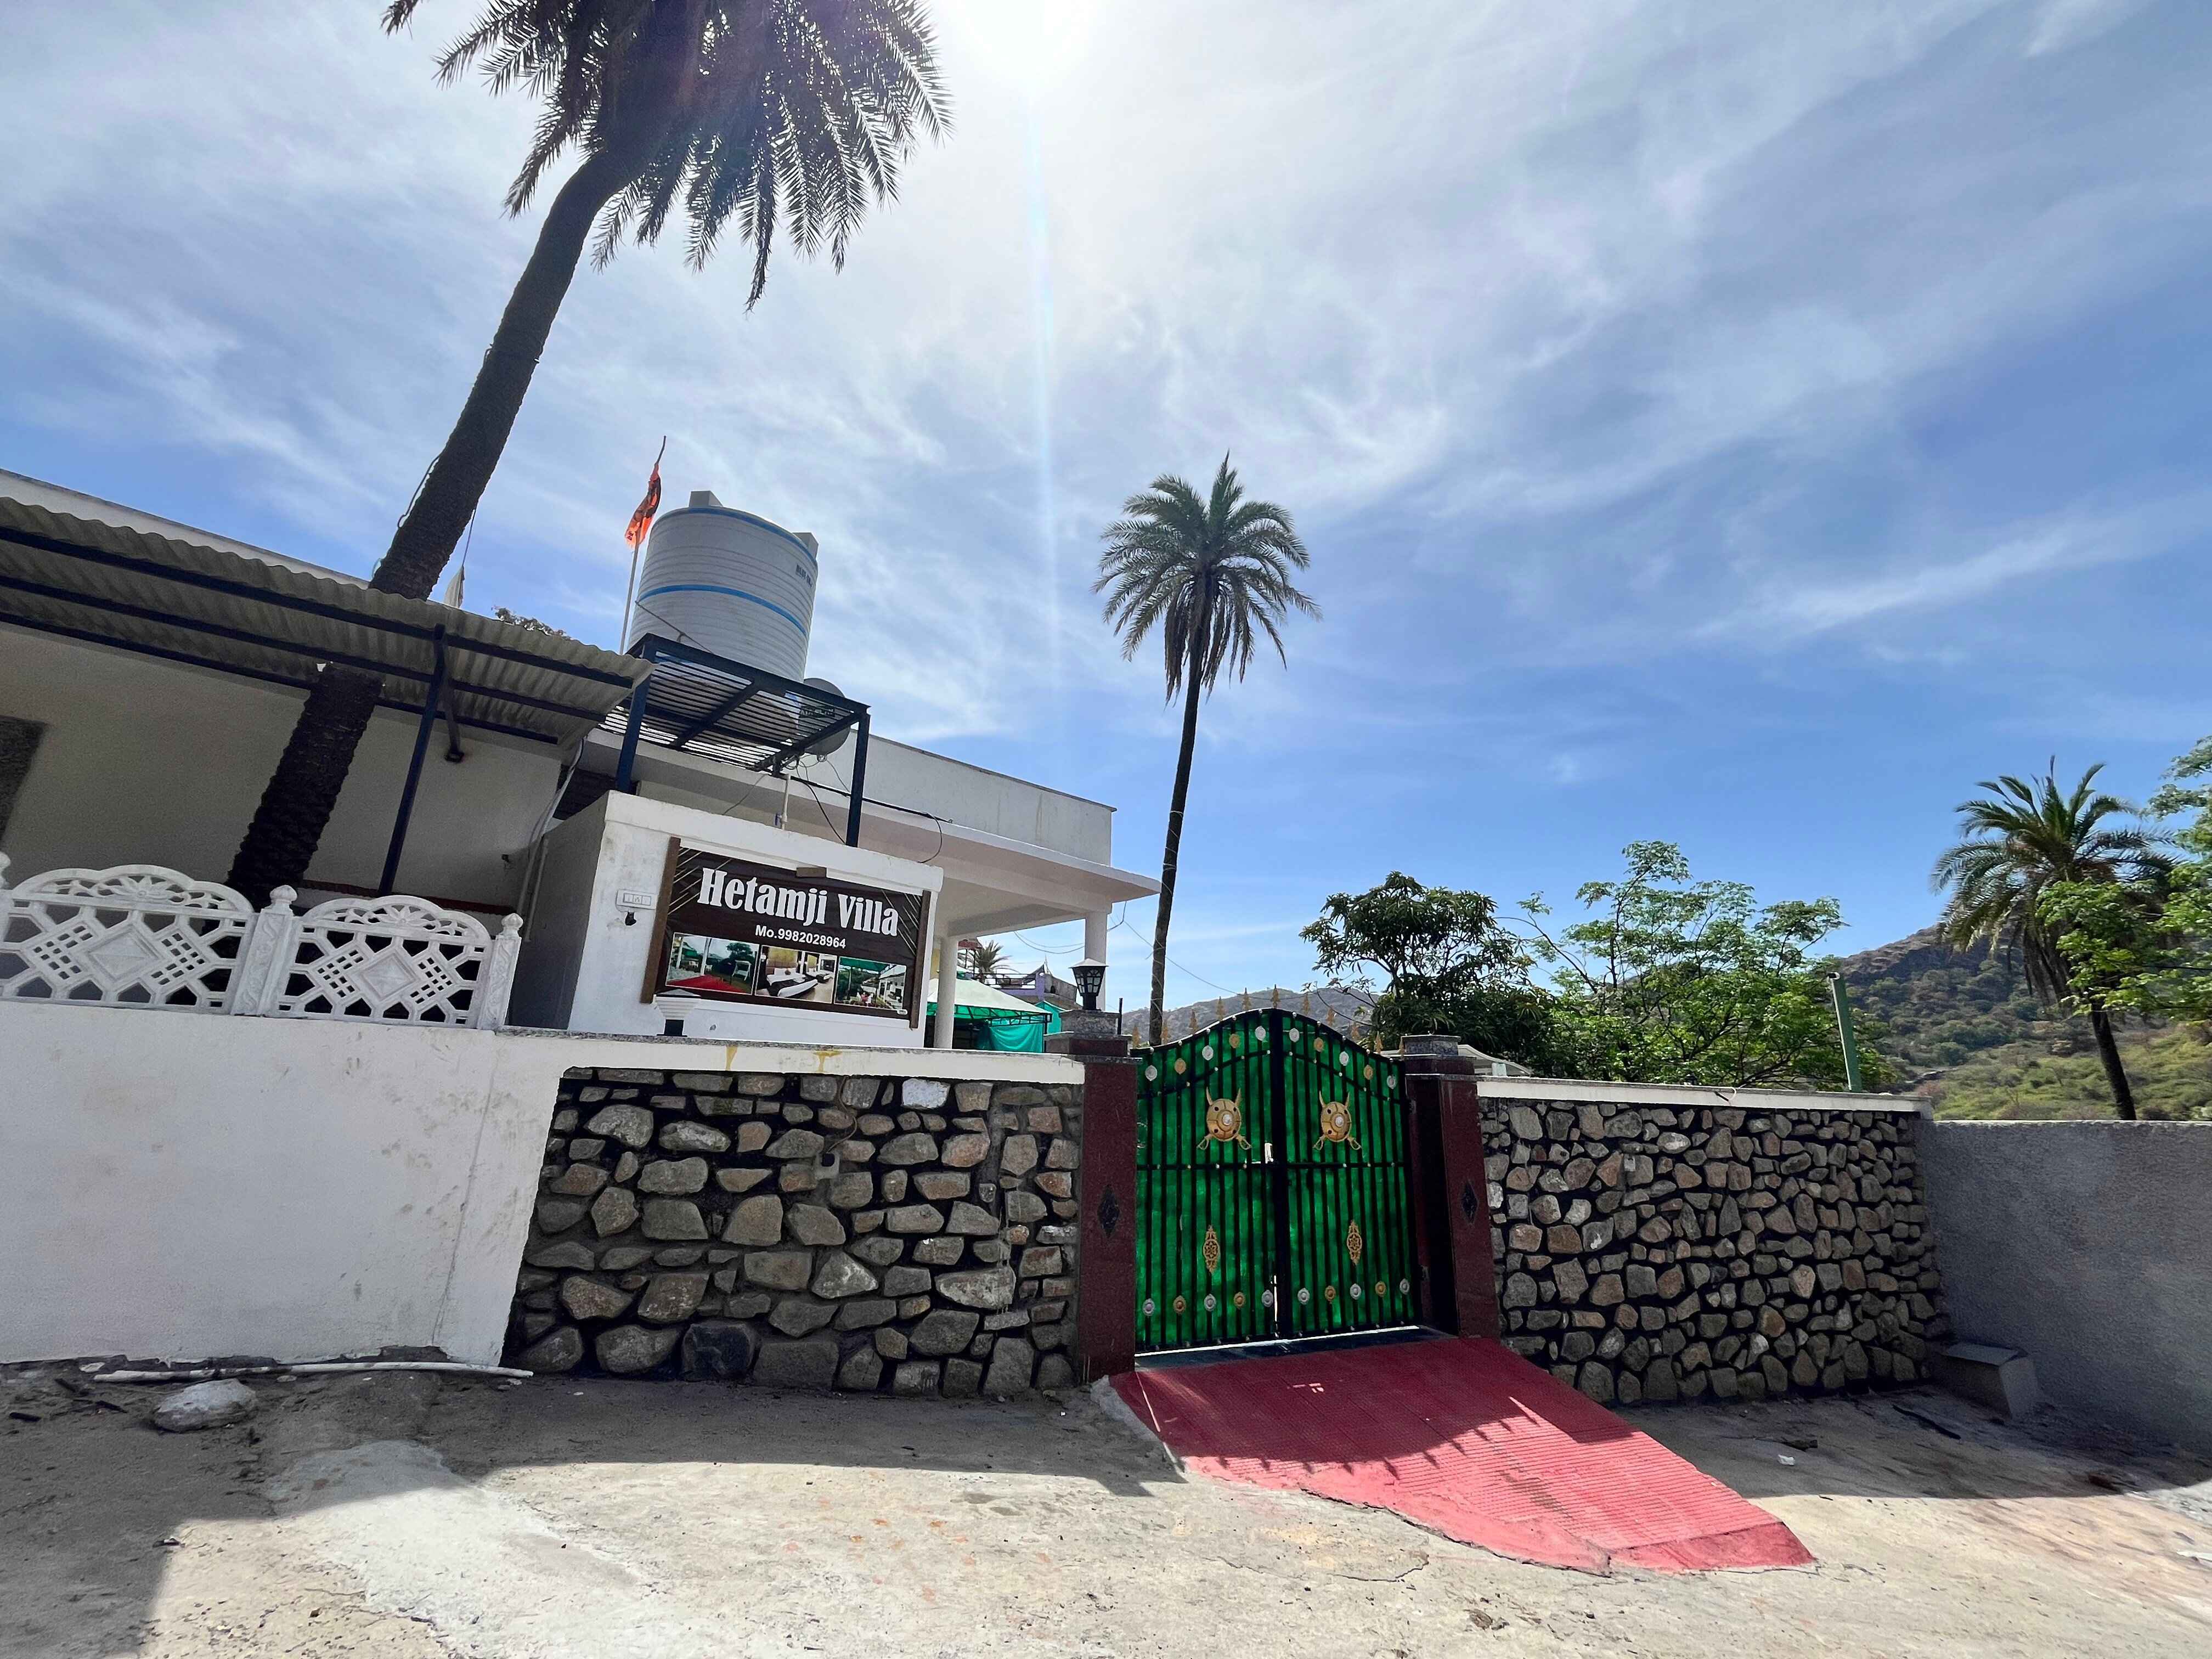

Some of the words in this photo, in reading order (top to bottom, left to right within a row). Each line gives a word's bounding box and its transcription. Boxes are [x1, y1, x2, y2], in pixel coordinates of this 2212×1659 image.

[697, 867, 827, 926] Hetamji
[838, 893, 899, 936] Villa
[755, 924, 846, 949] Mo.9982028964
